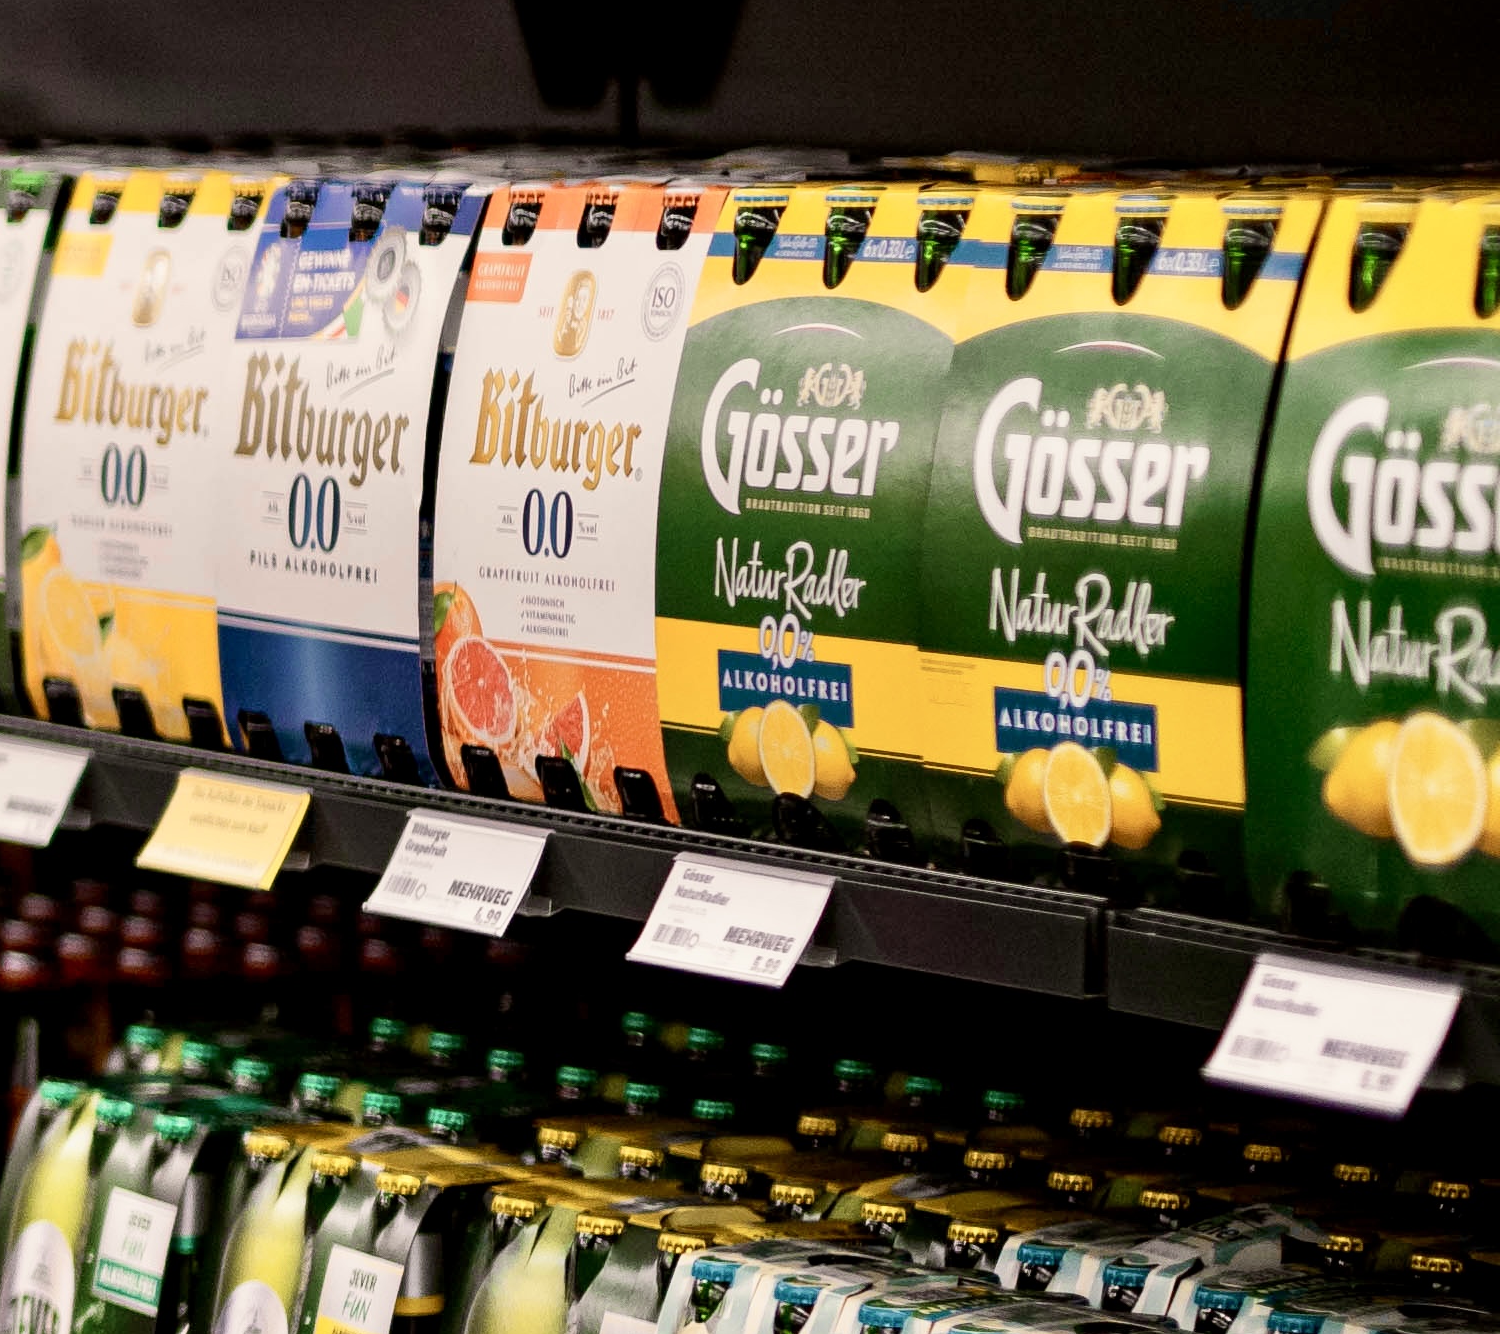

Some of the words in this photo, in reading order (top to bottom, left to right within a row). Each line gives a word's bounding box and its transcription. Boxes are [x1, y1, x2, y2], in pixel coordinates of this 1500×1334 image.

[650, 286, 675, 309] ISO
[54, 336, 209, 446] Bitburger
[234, 350, 410, 487] Bitburger
[469, 367, 642, 491] Bitburger
[702, 358, 900, 515] Gösser
[973, 378, 1210, 545] Gösser
[1307, 394, 1500, 576] Göss
[289, 473, 341, 553] 0.0
[523, 489, 574, 559] 0.0
[250, 550, 277, 568] PILS
[285, 555, 378, 583] ALKOHOLFREI
[479, 566, 540, 585] GRAPEFRUIT
[544, 574, 616, 593] ALKOHOLFREI
[715, 537, 866, 619] NaturRadler
[759, 613, 815, 669] 0,0%
[989, 568, 1175, 656] NaturRadler
[723, 669, 848, 702] ALKOHOLFREI
[1045, 651, 1112, 709] 0,0%
[999, 709, 1152, 746] ALKOHOLFREI
[405, 839, 448, 858] Grapefruit
[411, 821, 450, 842] Bitburger
[447, 879, 512, 907] MEHRWEG
[723, 926, 795, 954] MEHRWEG
